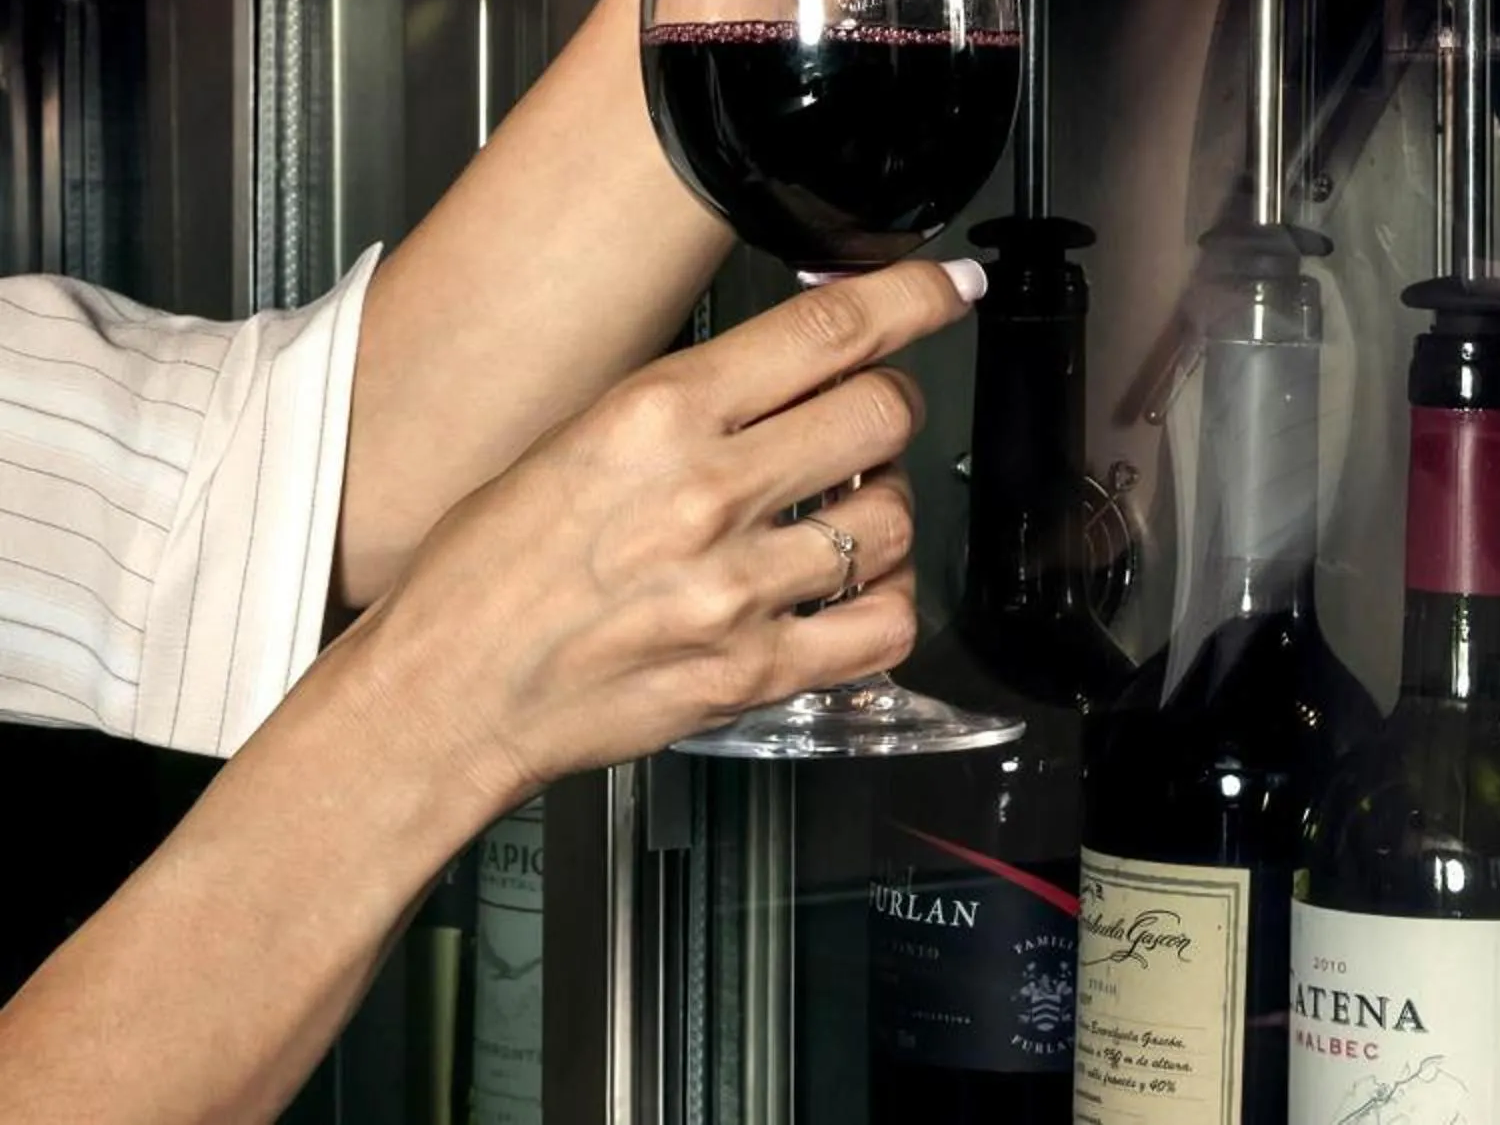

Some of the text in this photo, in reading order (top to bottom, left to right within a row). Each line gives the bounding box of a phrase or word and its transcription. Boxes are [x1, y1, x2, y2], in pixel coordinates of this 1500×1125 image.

[1312, 956, 1348, 975] 2010
[1289, 970, 1429, 1034] ATENA
[1295, 1028, 1380, 1061] MALBEC
